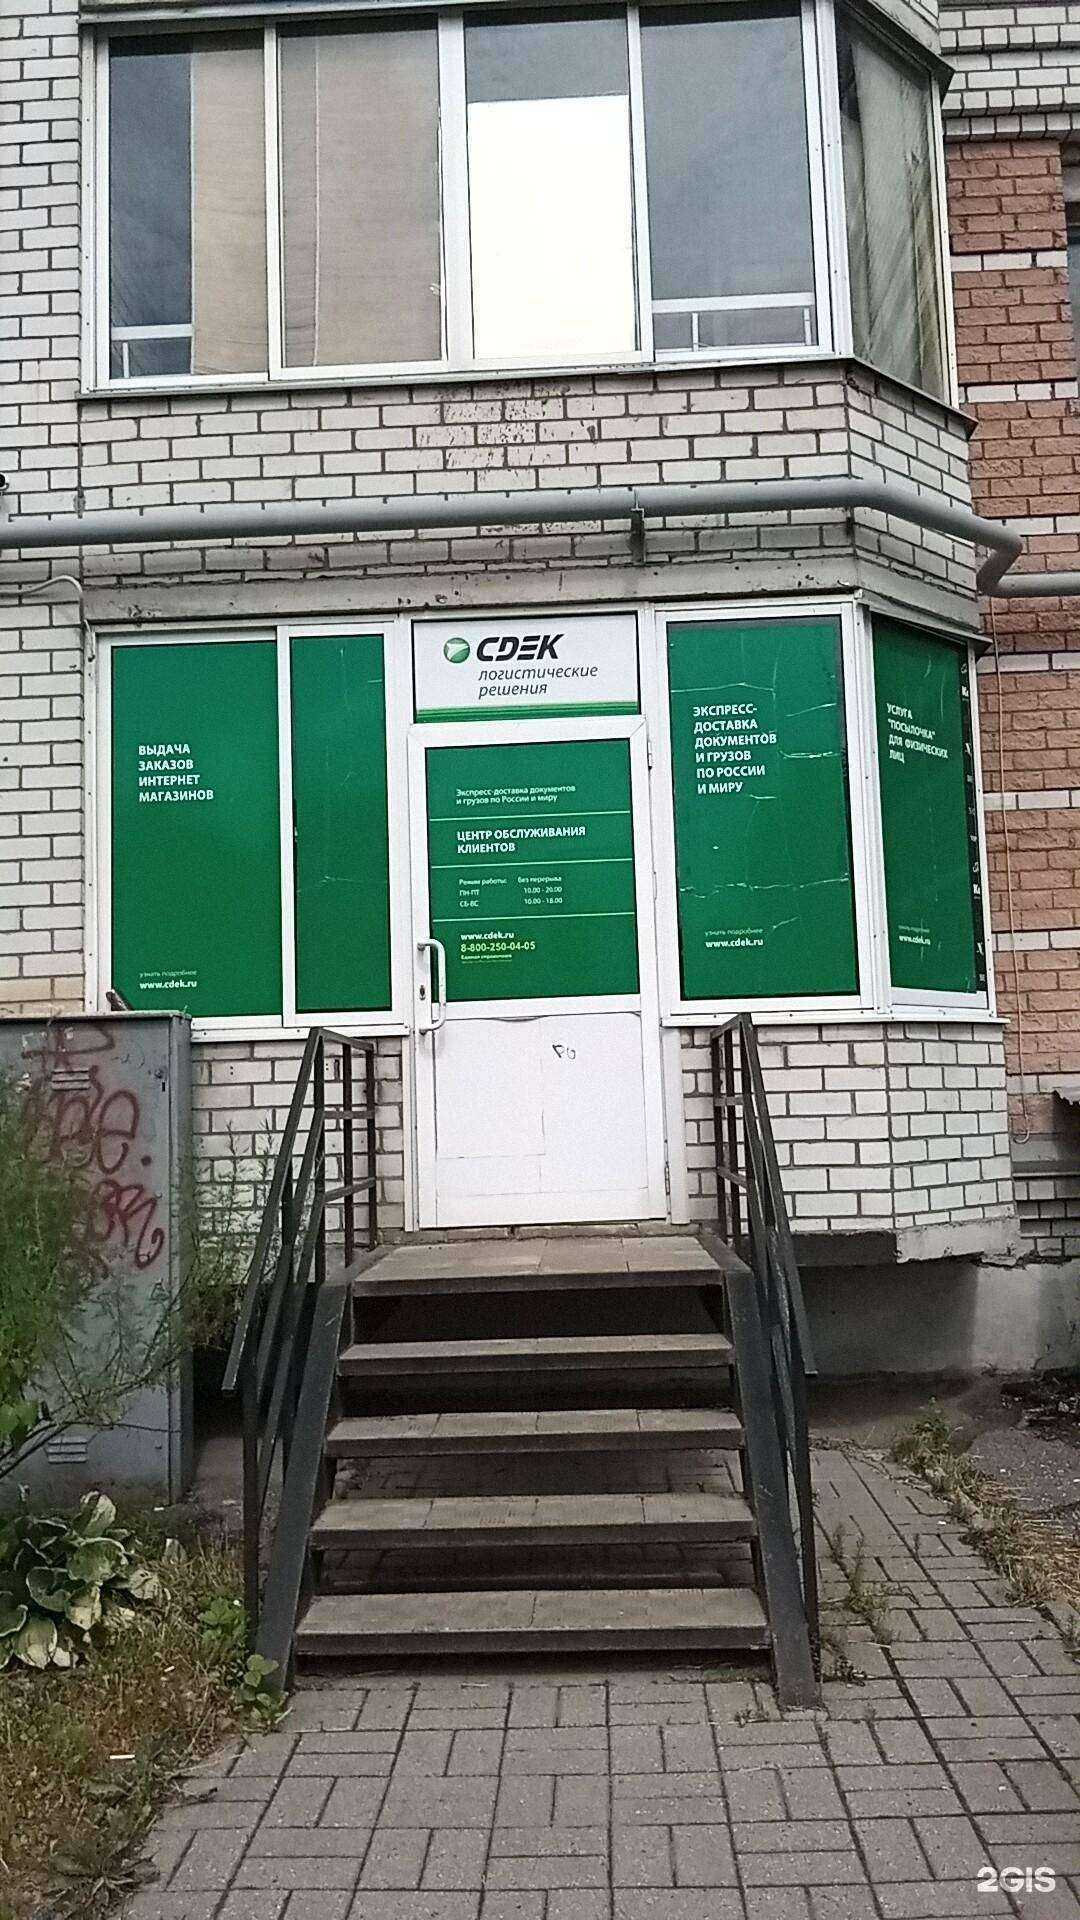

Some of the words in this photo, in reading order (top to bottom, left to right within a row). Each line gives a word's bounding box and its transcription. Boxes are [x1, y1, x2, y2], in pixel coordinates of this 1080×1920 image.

[476, 633, 565, 662] CDEK
[478, 666, 599, 681] логистические
[478, 683, 548, 700] решения
[693, 703, 758, 717] ЭКСПРЕСС-
[886, 702, 913, 720] УСЛУГА
[693, 718, 758, 735] ДОСТАВКА
[694, 733, 777, 750] ДОКУМЕНТОВ
[888, 733, 903, 747] ДЛЯ
[904, 738, 949, 759] ФИЗИЧЕСКИХ
[138, 743, 191, 757] ВЫДАЧА
[695, 752, 705, 763] И
[706, 750, 752, 762] ГРУЗОВ
[889, 749, 905, 764] ЛИЦ
[138, 759, 194, 771] ЗАКАЗОВ
[696, 767, 715, 779] ПО
[716, 765, 766, 778] РОССИИ
[138, 774, 201, 787] ИНТЕРНЕТ
[456, 787, 529, 797] Экспресс-доставка
[529, 785, 577, 794] документов
[697, 783, 707, 795] И
[708, 781, 744, 794] МИРУ
[139, 789, 215, 802] МАГАЗИНОВ
[463, 797, 489, 806] грузов
[501, 795, 530, 803] России
[537, 794, 558, 803] миру
[456, 830, 493, 842] ЦЕНТР
[493, 826, 587, 840] ОБСЛУЖИВАНИЯ
[457, 842, 516, 854] КЛИЕНТОВ
[460, 931, 515, 941] www.cdek.ru
[705, 938, 764, 948] www.cdek.ru
[460, 941, 536, 953] 8-800-250-04-05
[139, 980, 198, 989] www.cdek.ru
